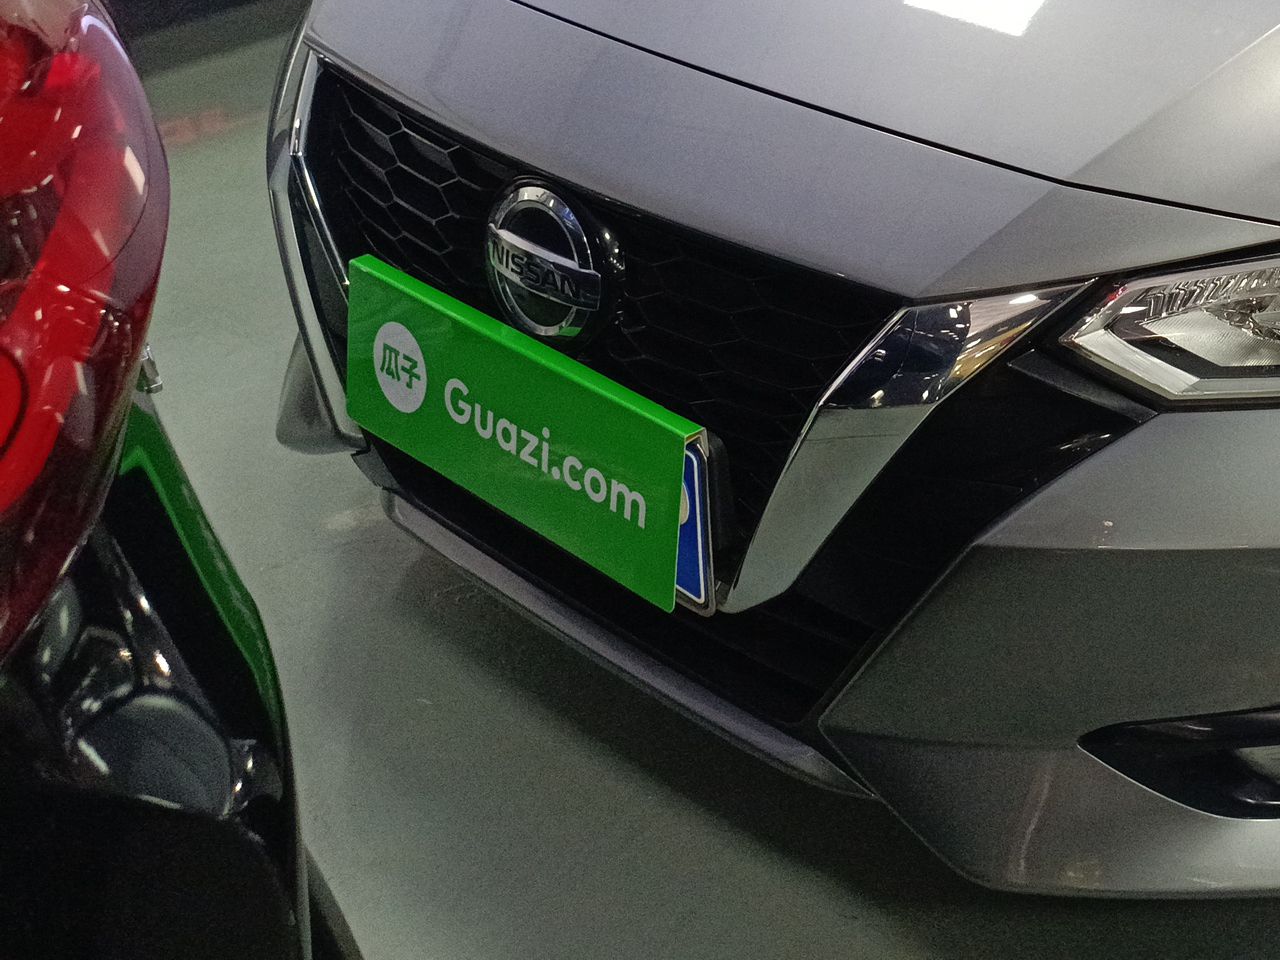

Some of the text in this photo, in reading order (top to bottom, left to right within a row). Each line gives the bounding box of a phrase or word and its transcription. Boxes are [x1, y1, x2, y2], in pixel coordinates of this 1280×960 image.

[493, 240, 578, 300] NISSAN
[380, 343, 422, 390] 瓜子
[444, 379, 647, 529] Guazi.com
